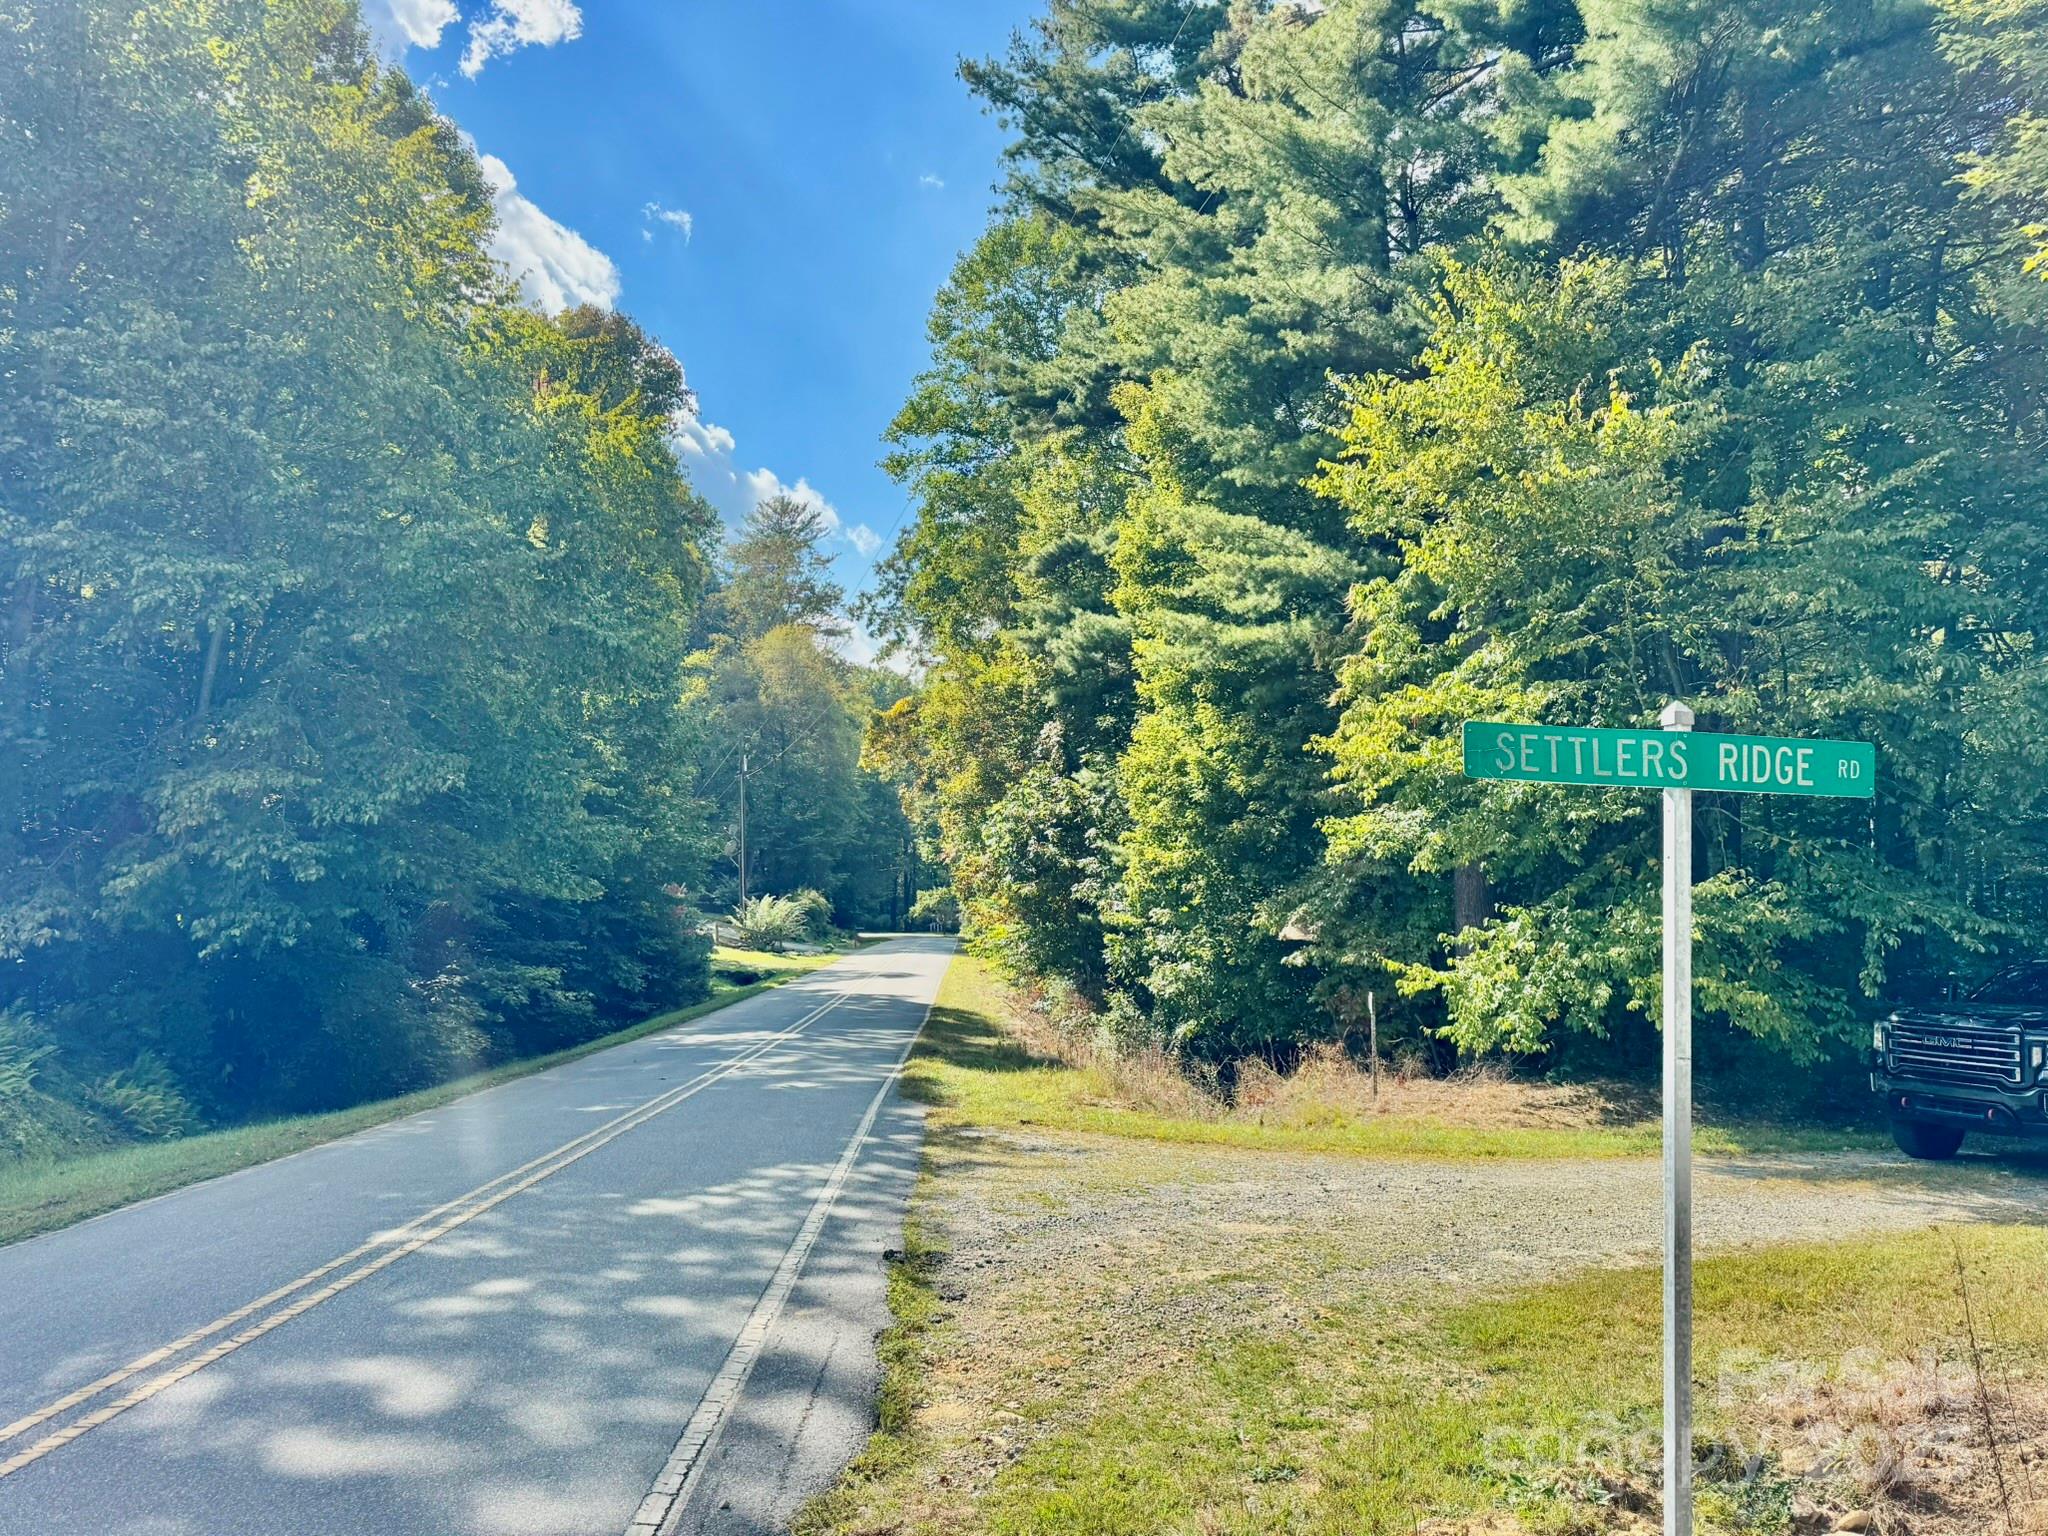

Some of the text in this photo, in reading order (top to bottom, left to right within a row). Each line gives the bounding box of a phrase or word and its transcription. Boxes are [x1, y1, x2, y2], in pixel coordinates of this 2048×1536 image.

[1496, 731, 1861, 786] SETTLERS RIDGE RD
